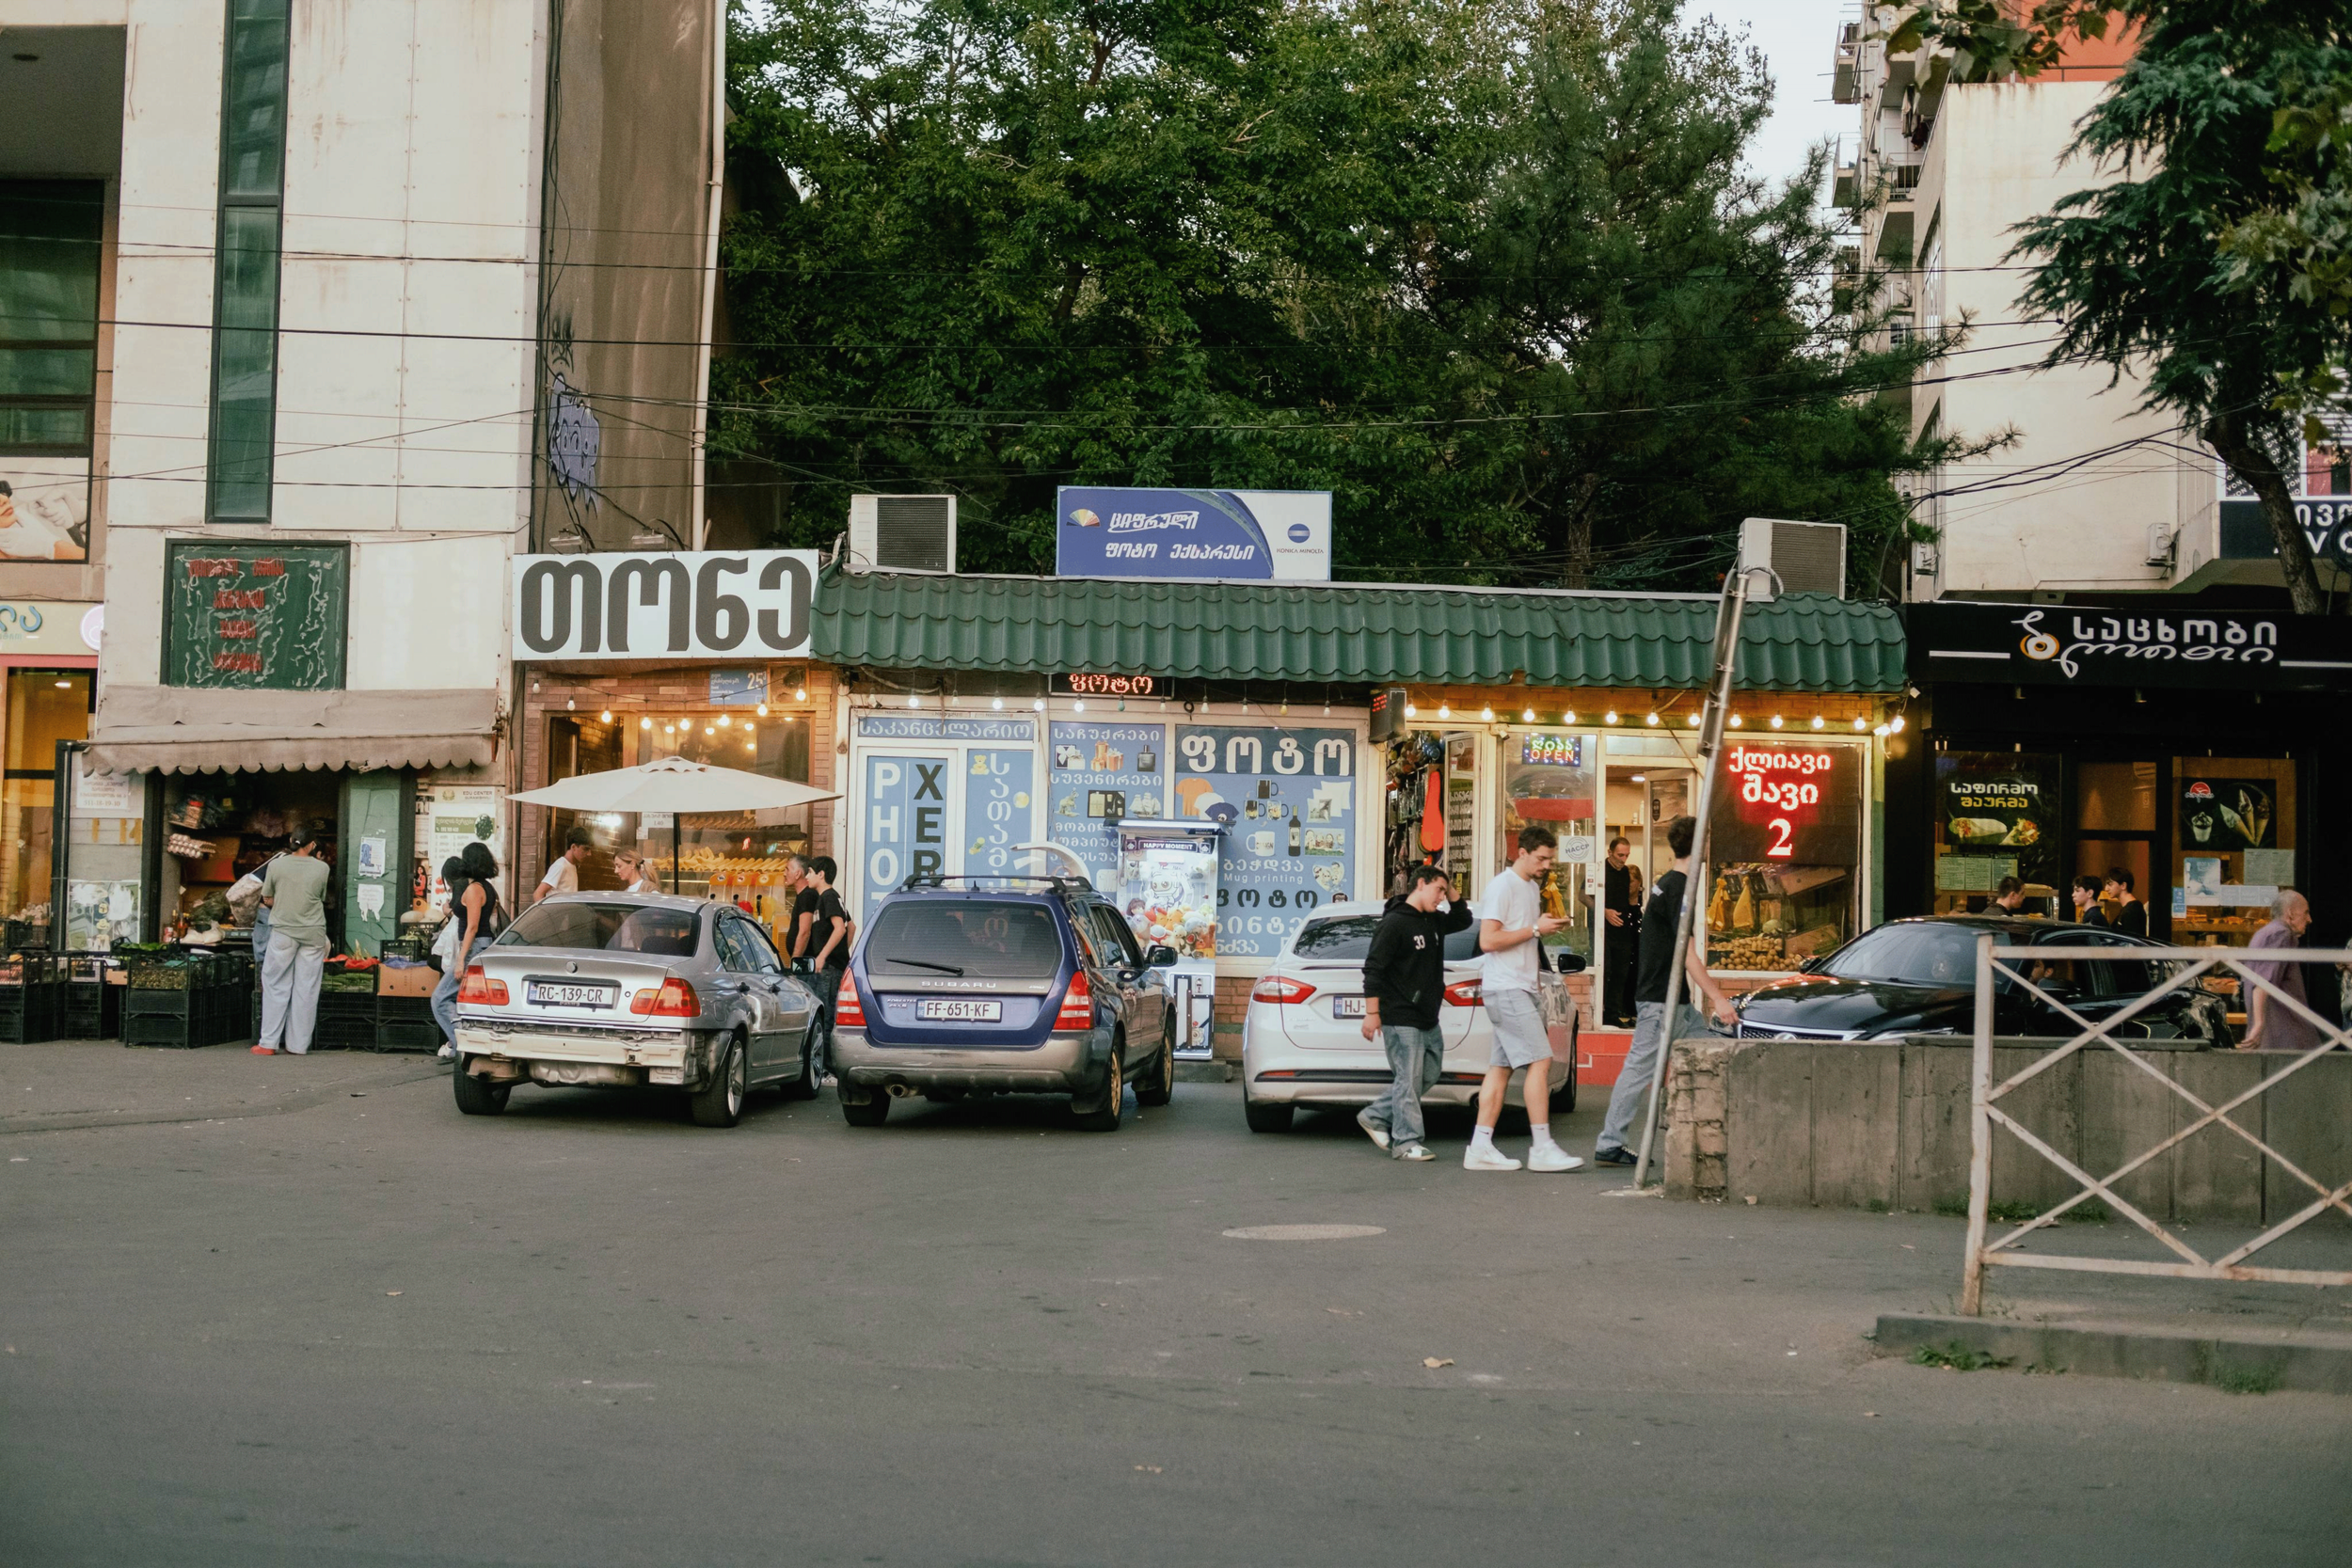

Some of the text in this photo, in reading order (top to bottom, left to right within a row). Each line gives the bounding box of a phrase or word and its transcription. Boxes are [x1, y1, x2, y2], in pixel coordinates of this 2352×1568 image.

[1105, 543, 1255, 561] ფოტო ექსპრესი
[520, 556, 812, 653] თონე
[2073, 616, 2278, 645] საცხობი
[1069, 673, 1153, 694] ფოტო
[860, 721, 1031, 738] საკანცელარიო
[1054, 727, 1160, 741] საჩუქრები
[1181, 735, 1350, 776] ფოტო
[1531, 750, 1575, 761] OPEN
[1729, 746, 1831, 774] ქლიავი
[1050, 773, 1163, 786] სუვენირები
[1742, 773, 1819, 811] შავი
[1950, 783, 2039, 795] საფირმო
[1961, 797, 2028, 808] შაურმა
[1767, 818, 1793, 856] 2
[1565, 843, 1590, 854] HACCP
[1223, 859, 1305, 872] ბეჭდვა
[1223, 873, 1303, 885] Mug printing
[1413, 935, 1426, 950] 33
[538, 987, 603, 1003] RC-139-CR
[926, 1002, 990, 1018] FF-651-KF
